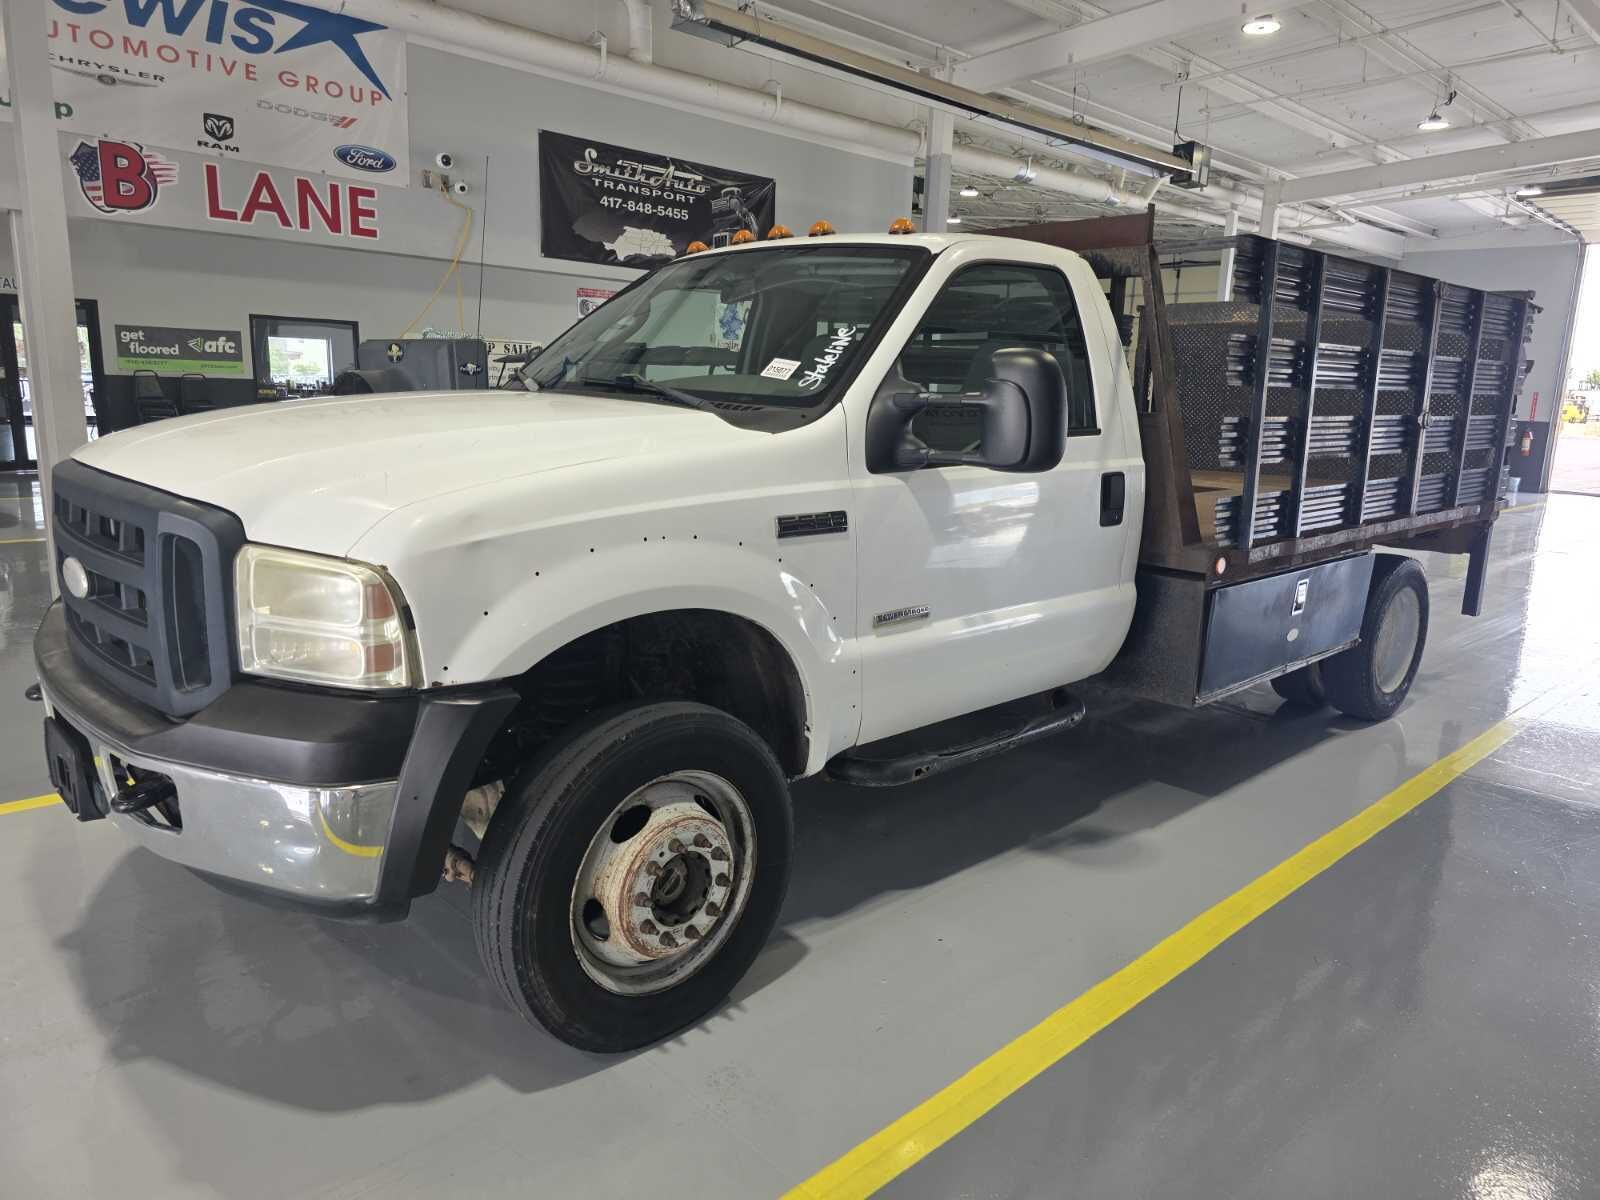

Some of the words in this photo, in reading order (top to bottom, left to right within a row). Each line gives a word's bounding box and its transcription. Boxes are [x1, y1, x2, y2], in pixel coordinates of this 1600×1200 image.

[48, 20, 257, 82] UTOMOTIVE
[278, 70, 384, 106] GROUP
[197, 140, 240, 153] RAM
[347, 149, 384, 168] Ford
[204, 164, 379, 239] LANE
[592, 178, 696, 204] TRANSPORT
[600, 196, 689, 221] 417-848-5455
[121, 330, 144, 342] get
[204, 336, 236, 354] afc
[129, 342, 180, 355] floored
